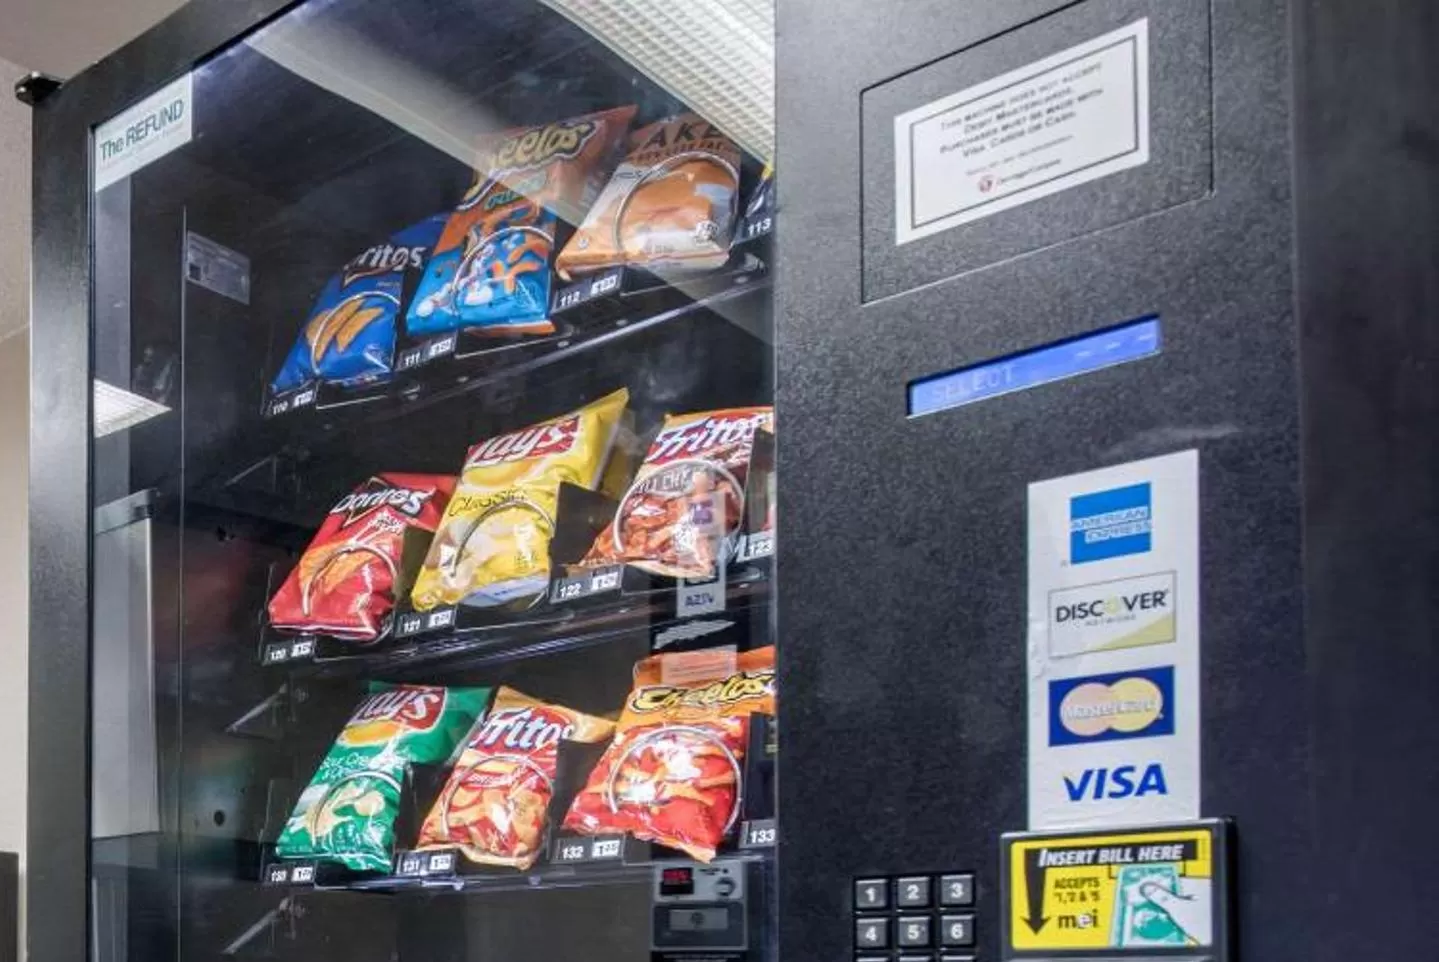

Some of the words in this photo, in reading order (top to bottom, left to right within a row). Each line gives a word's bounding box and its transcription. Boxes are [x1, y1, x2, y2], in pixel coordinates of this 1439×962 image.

[100, 138, 123, 161] The
[125, 99, 185, 147] REFUND
[748, 219, 772, 235] 113
[345, 244, 427, 272] ritos
[330, 485, 437, 515] Doritos
[1073, 507, 1148, 531] AMERICAN
[1087, 521, 1151, 542] EXPRESS
[750, 541, 773, 555] 123
[560, 584, 582, 597] 122
[1056, 590, 1167, 623] DISCOVER
[403, 619, 421, 633] 121
[1063, 764, 1168, 801] VISA
[750, 829, 775, 843] 133
[562, 846, 583, 859] 132
[1038, 848, 1095, 867] INSERT
[1099, 846, 1134, 864] BILL
[1138, 844, 1184, 861] HERE
[865, 887, 876, 903] 1
[906, 884, 920, 900] 2
[950, 882, 964, 899] 3
[1054, 876, 1100, 890] ACCEPTS
[1058, 909, 1099, 929] mei
[864, 925, 877, 941] 4
[907, 924, 919, 940] 5
[950, 922, 964, 939] 6
